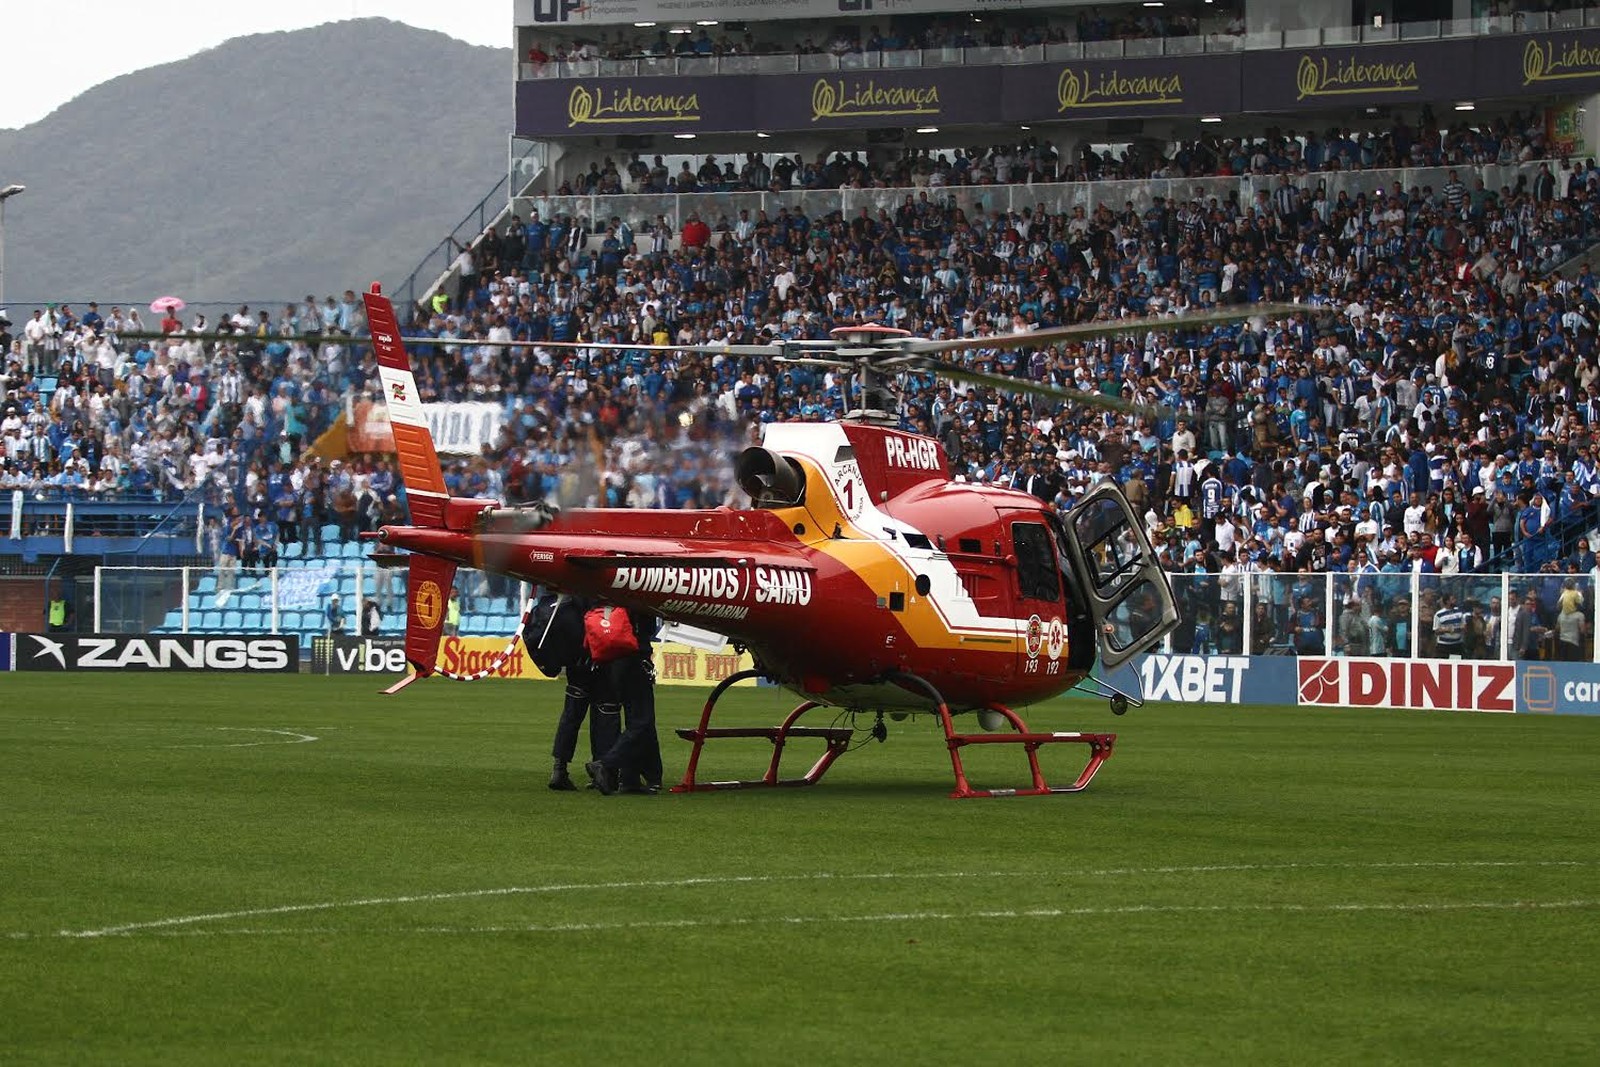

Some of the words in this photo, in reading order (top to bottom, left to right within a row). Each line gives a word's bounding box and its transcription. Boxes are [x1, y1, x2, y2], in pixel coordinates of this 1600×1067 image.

[1084, 69, 1182, 101] Liderança
[1320, 56, 1417, 90] Liderança
[595, 87, 700, 118] Liderança
[839, 79, 939, 111] Liderança
[886, 436, 940, 470] PR-HGR
[834, 464, 863, 487] ARCANJO
[843, 479, 853, 510] 1
[612, 567, 739, 600] BOMBEIROS
[755, 567, 812, 606] SAMU
[659, 599, 698, 614] SANTA
[695, 602, 750, 620] CATARINA
[77, 638, 288, 669] ZANGS
[1024, 659, 1039, 673] 193
[1046, 661, 1060, 675] 192
[1141, 655, 1249, 704] 1XBET
[1349, 662, 1515, 710] DINIZ
